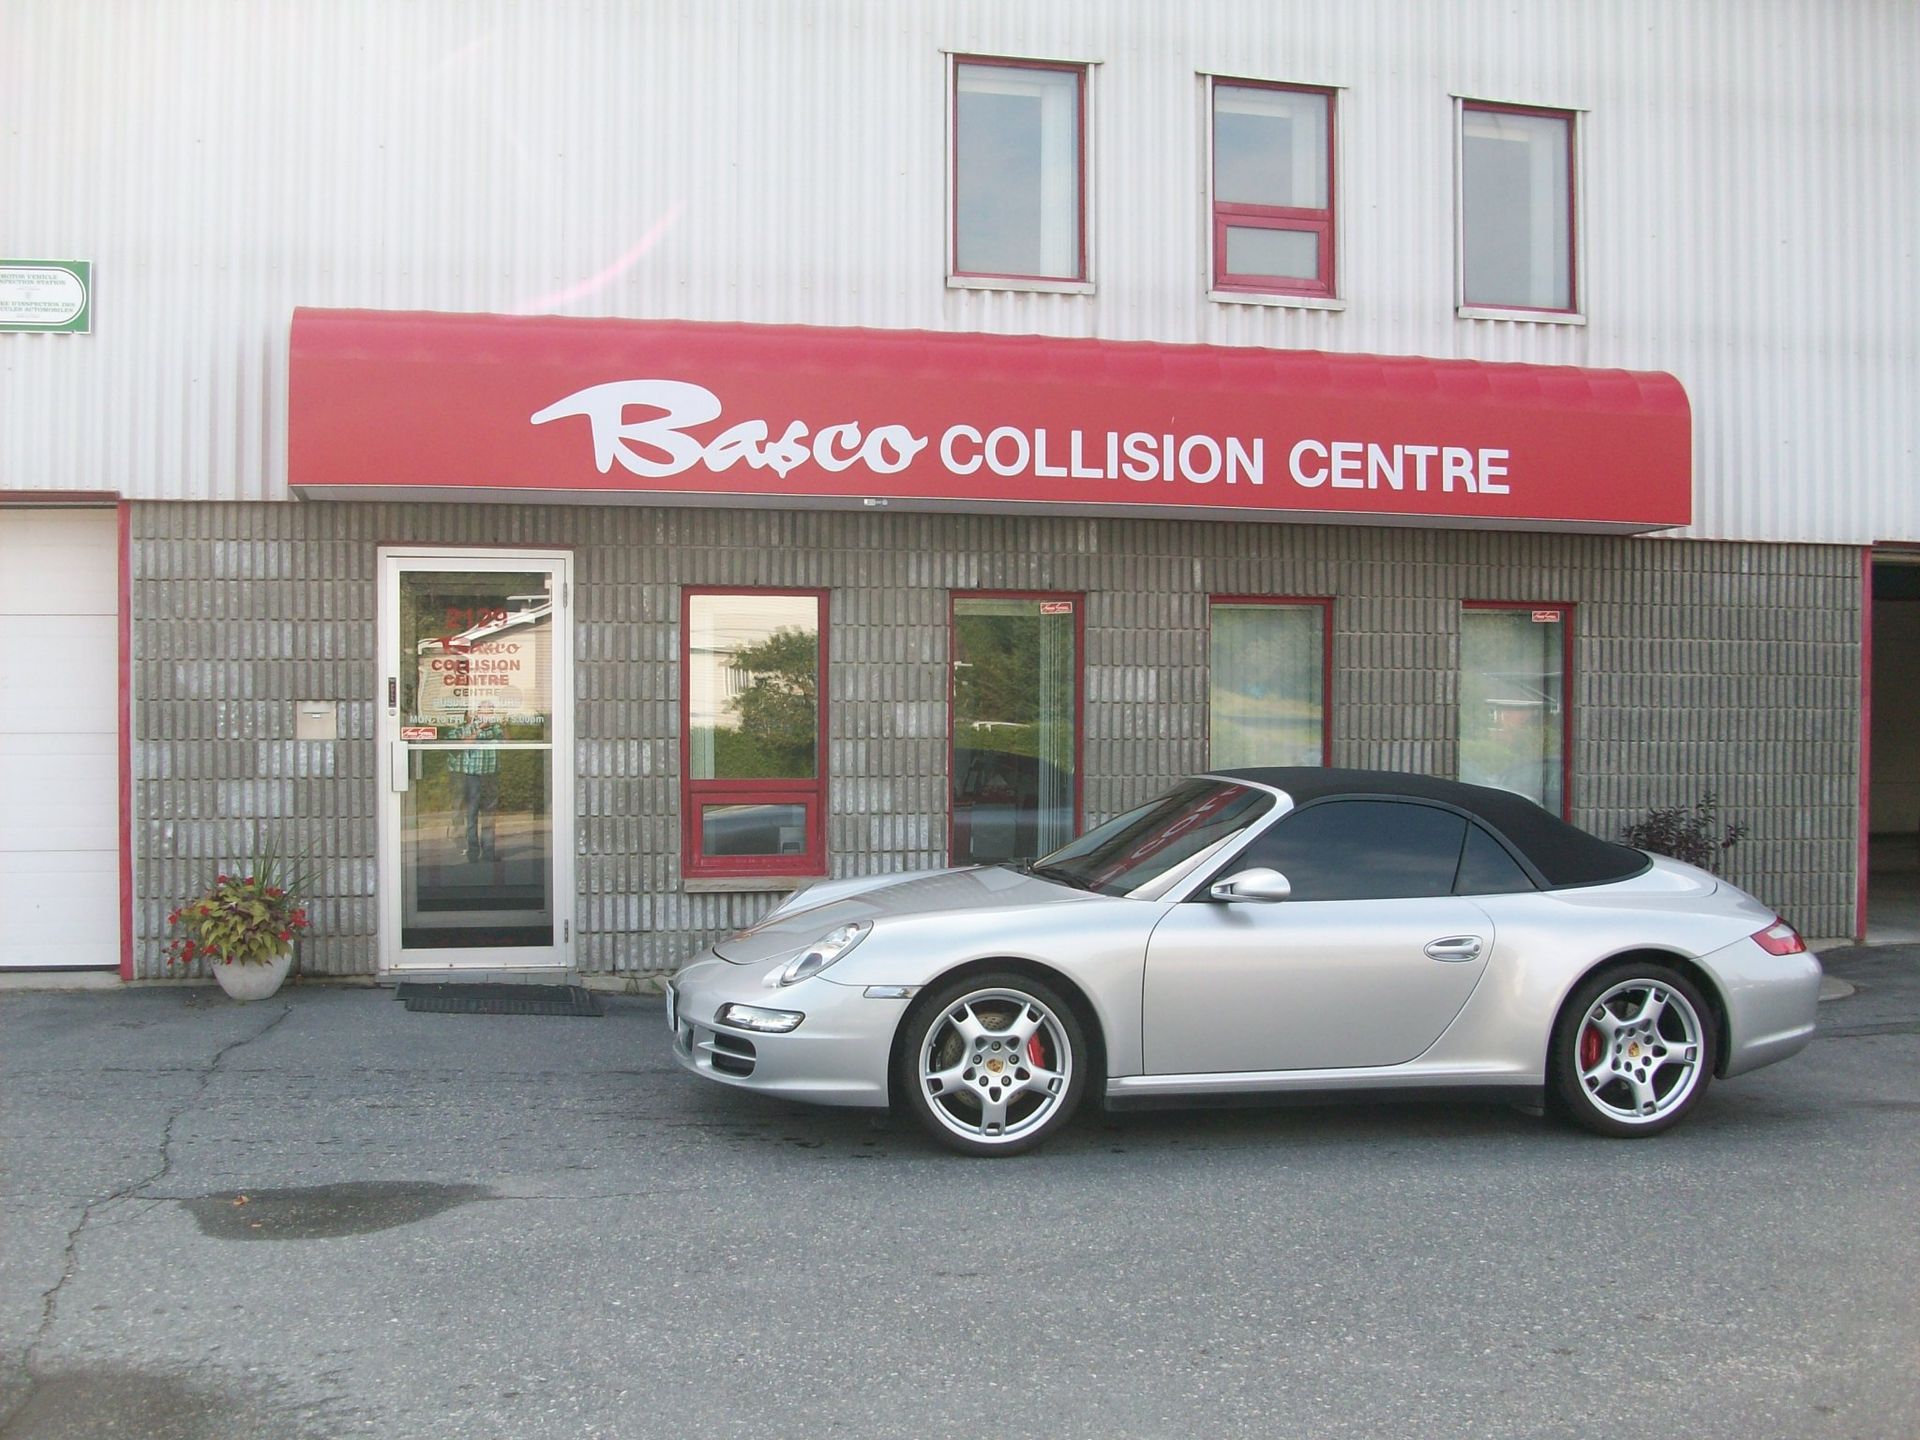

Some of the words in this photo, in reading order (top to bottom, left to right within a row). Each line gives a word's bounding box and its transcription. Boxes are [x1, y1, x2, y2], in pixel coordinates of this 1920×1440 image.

[531, 380, 929, 479] Basco
[939, 424, 1265, 486] COLLISION
[1289, 439, 1511, 496] CENTRE
[443, 674, 509, 686] CENTRE
